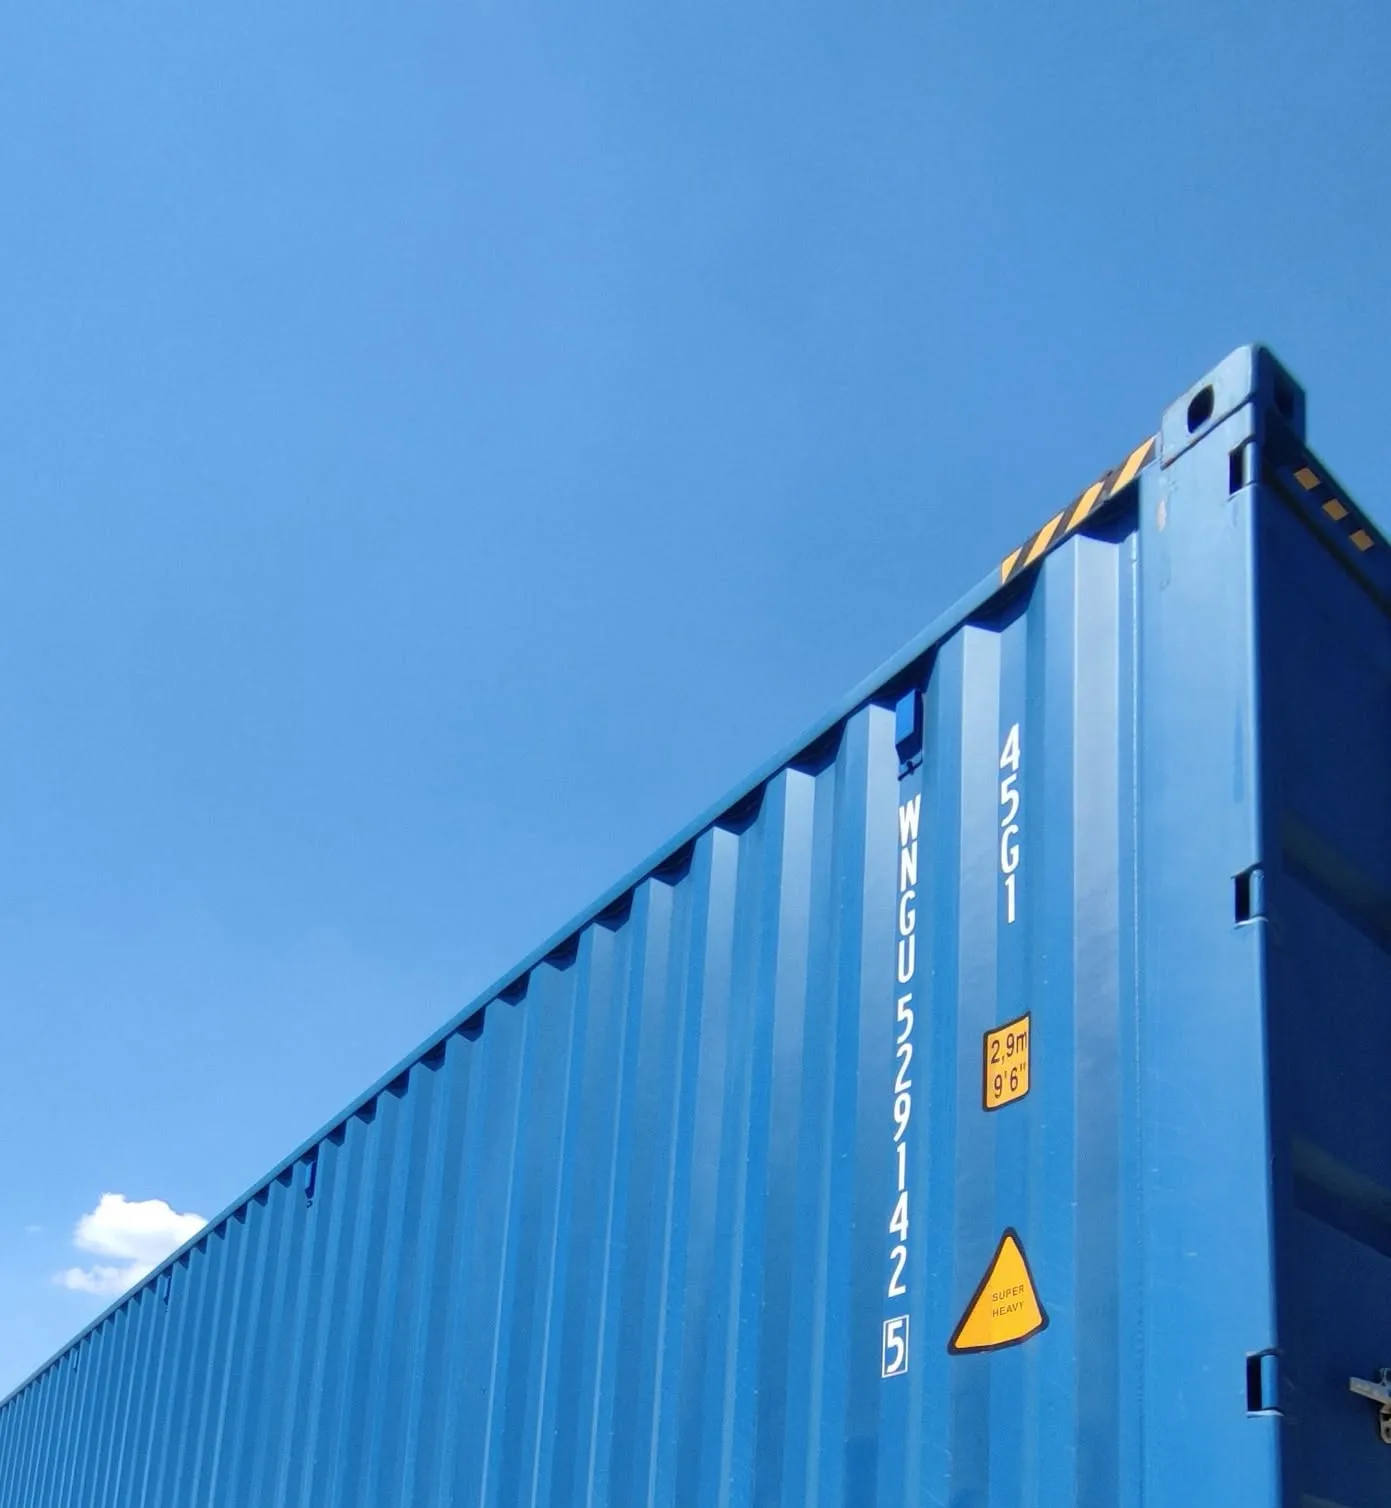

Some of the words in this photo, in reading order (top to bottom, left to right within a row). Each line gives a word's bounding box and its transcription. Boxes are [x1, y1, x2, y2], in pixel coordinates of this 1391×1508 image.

[1000, 723, 1021, 924] 45G1
[898, 794, 921, 983] WNGU
[888, 993, 914, 1298] 529142
[886, 1319, 905, 1374] 5
[991, 1284, 1025, 1302] SUPER
[992, 1301, 1025, 1318] HEAVY
